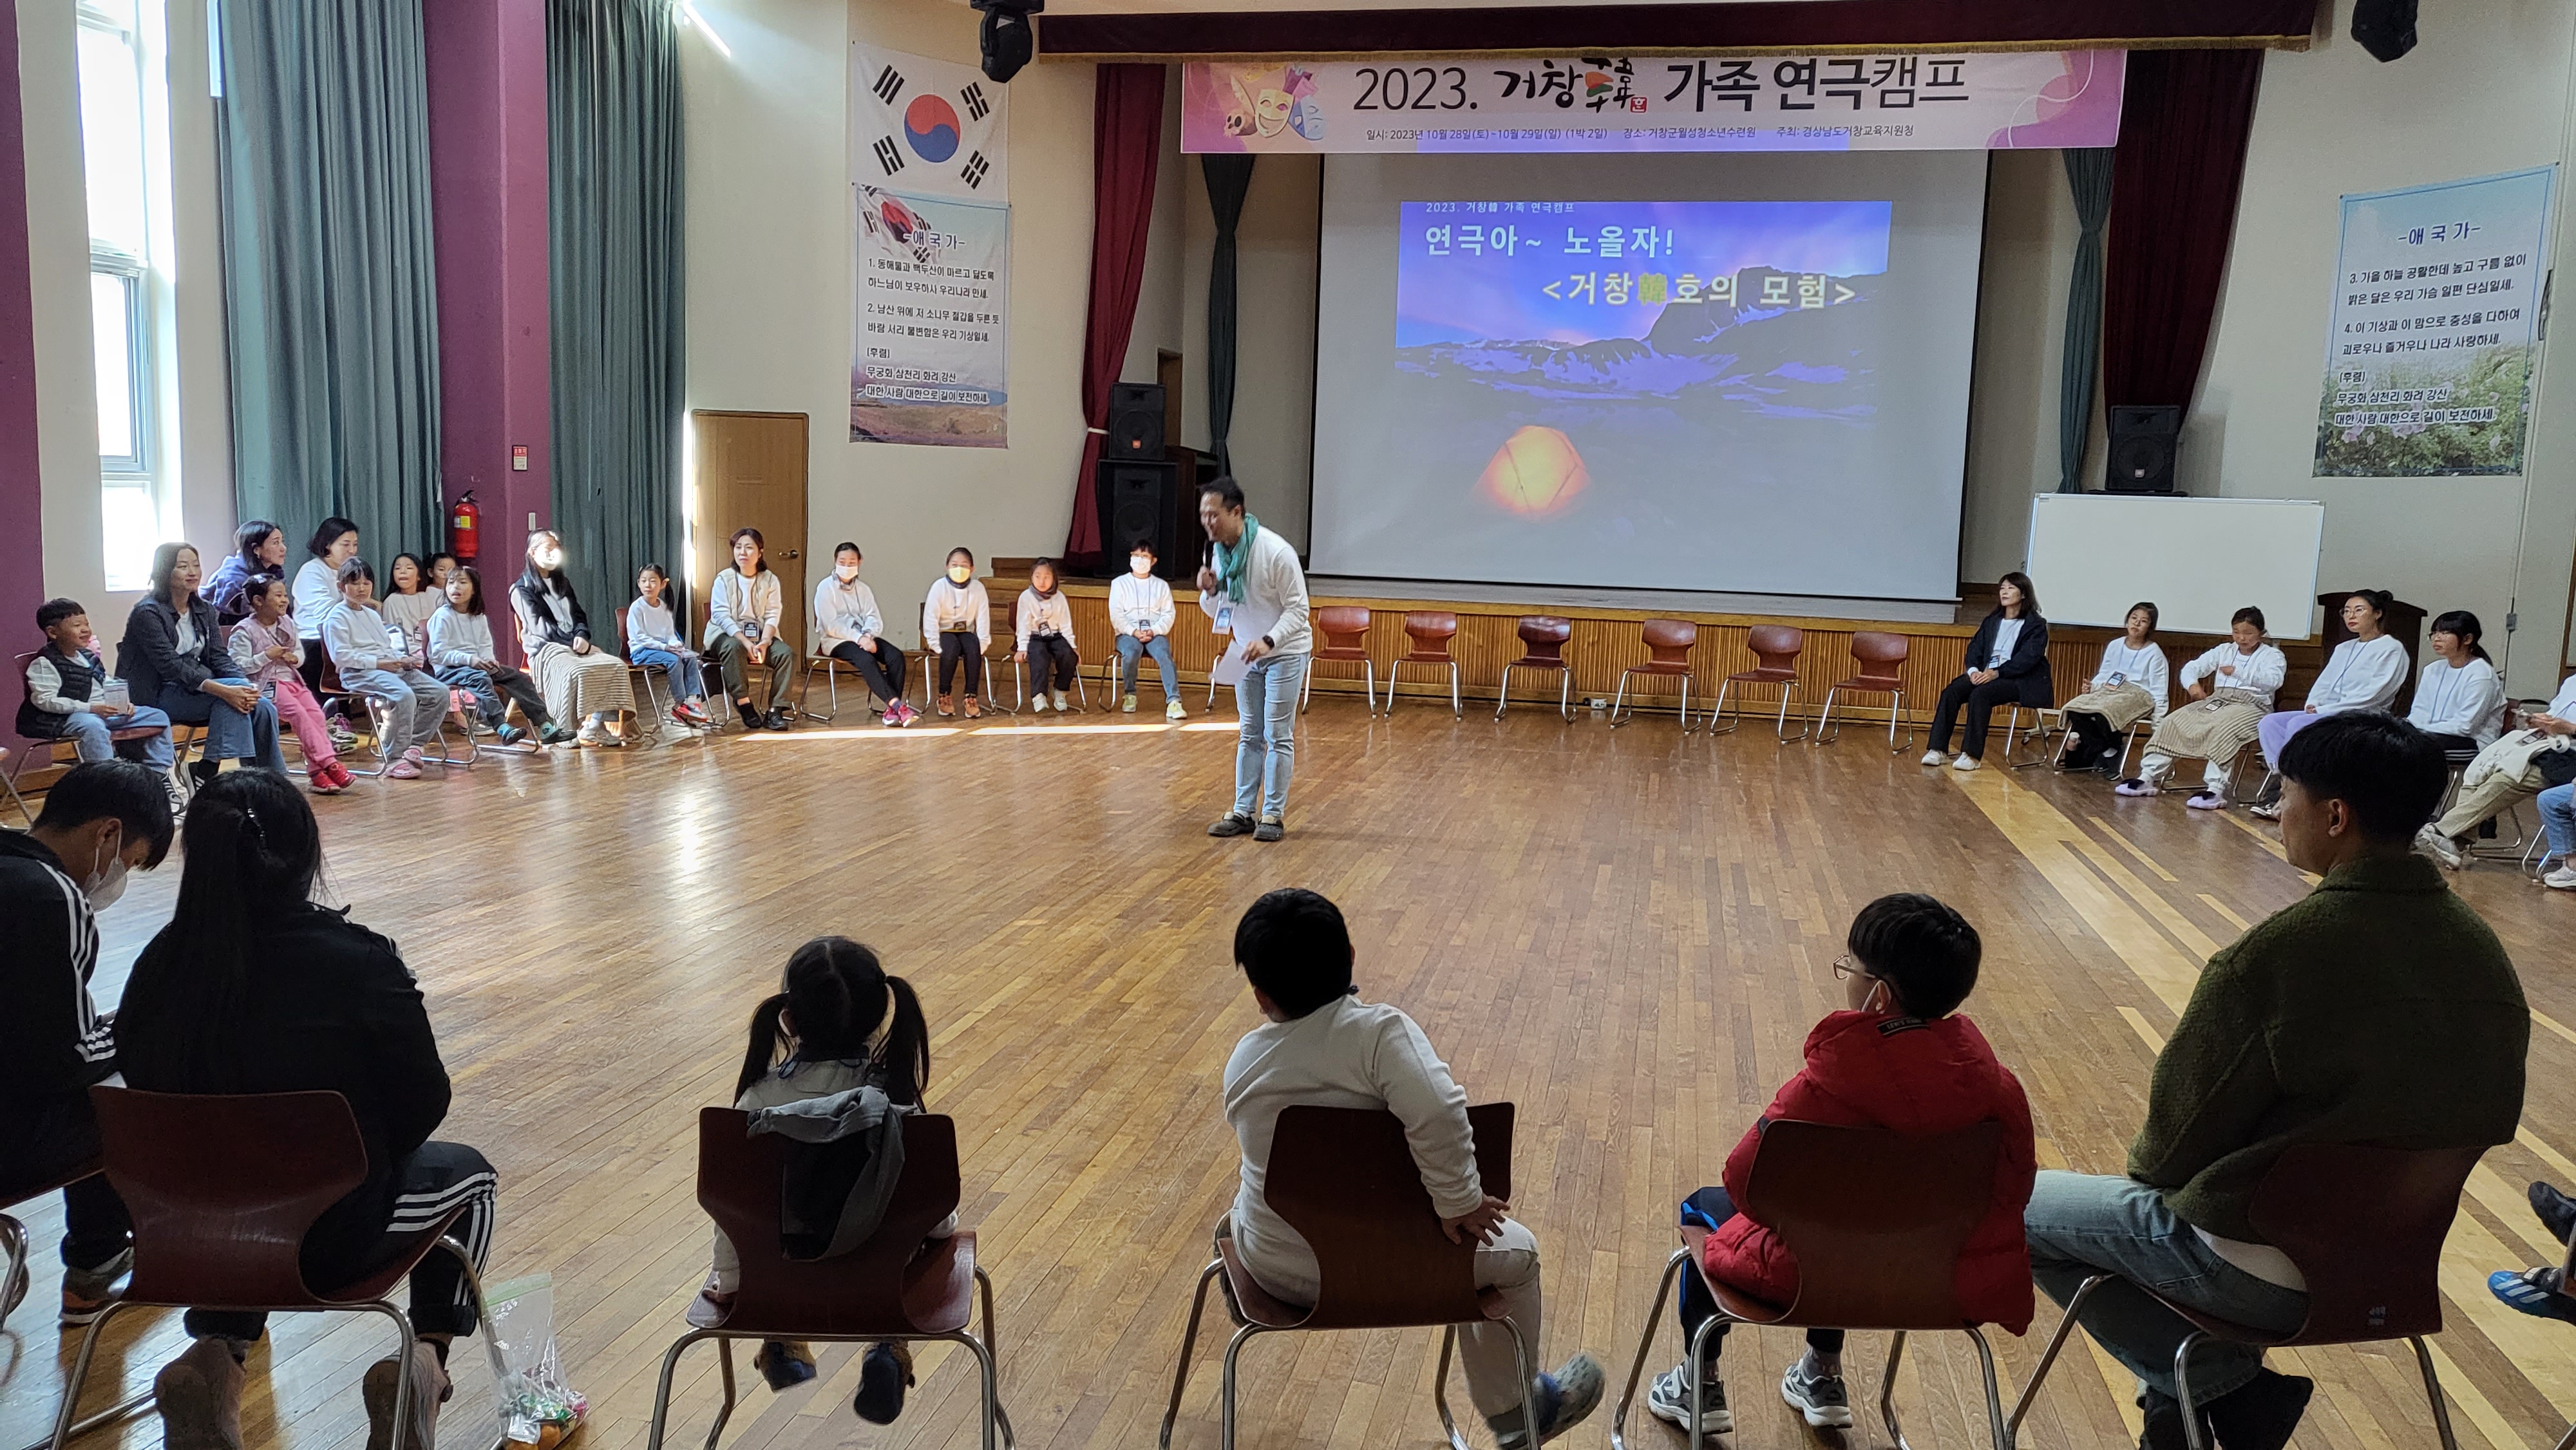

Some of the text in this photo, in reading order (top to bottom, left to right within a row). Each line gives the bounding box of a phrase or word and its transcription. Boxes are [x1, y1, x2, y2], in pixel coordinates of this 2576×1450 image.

[1354, 67, 1477, 110] 2023.
[1664, 60, 1761, 112] 가족
[1773, 57, 1969, 110] 연극캠프
[1367, 129, 1388, 140] 일시:
[1390, 129, 1423, 140] 2023년
[1427, 129, 1447, 140] 10월
[1623, 127, 1646, 138] 장소:
[1777, 125, 1914, 137] 주최: 경상남도거창교육지원청
[1426, 203, 1460, 212] 2023.
[1504, 202, 1525, 213] 가족
[1531, 202, 1575, 213] 연극캠프
[1426, 225, 1672, 258] 연극아~ 노올자!
[878, 259, 910, 272] 동해물과
[913, 263, 944, 276] 백두산이
[947, 267, 970, 278] 마르고
[2362, 271, 2380, 283] 가을
[2383, 268, 2403, 281] 하늘
[2452, 260, 2474, 274] 높고
[2477, 257, 2500, 270] 구름
[2504, 253, 2526, 268] 없이
[868, 278, 902, 290] 하느님이
[905, 281, 937, 294] 보우하사
[940, 286, 970, 297] 우리나라
[1759, 274, 1856, 308] 모험>
[2348, 279, 2514, 306] 밝은 달은 우리 가슴 일편 단심일세.
[877, 303, 895, 315] 남산
[897, 306, 913, 317] 위에
[916, 308, 923, 318] 저
[926, 309, 950, 320] 소나무
[2356, 322, 2365, 333] 이
[2368, 319, 2398, 332] 기상과
[2401, 319, 2410, 330] 이
[2414, 315, 2447, 330] 맘으로
[2486, 308, 2520, 322] 다하여
[867, 323, 885, 333] 바람
[887, 325, 904, 335] 서리
[907, 326, 939, 339] 불변함은
[942, 330, 957, 340] 우리
[867, 348, 890, 359] (후렴)
[2342, 343, 2382, 355] 괴로우나
[2385, 339, 2427, 353] 즐거우나
[2430, 337, 2451, 350] 나라
[895, 370, 920, 381] 삼천리
[923, 372, 939, 381] 화려
[942, 372, 956, 382] 강산
[2339, 371, 2365, 383] (후렴)
[867, 386, 884, 397] 대한
[887, 387, 903, 397] 사람
[906, 389, 938, 400] 대한으로
[940, 391, 956, 400] 길이
[2338, 388, 2447, 404] 무궁화 삼천리 화려 강산
[2336, 413, 2354, 425] 대한
[2357, 413, 2377, 424] 사람
[2380, 411, 2420, 424] 대한으로
[2423, 410, 2445, 422] 길이
